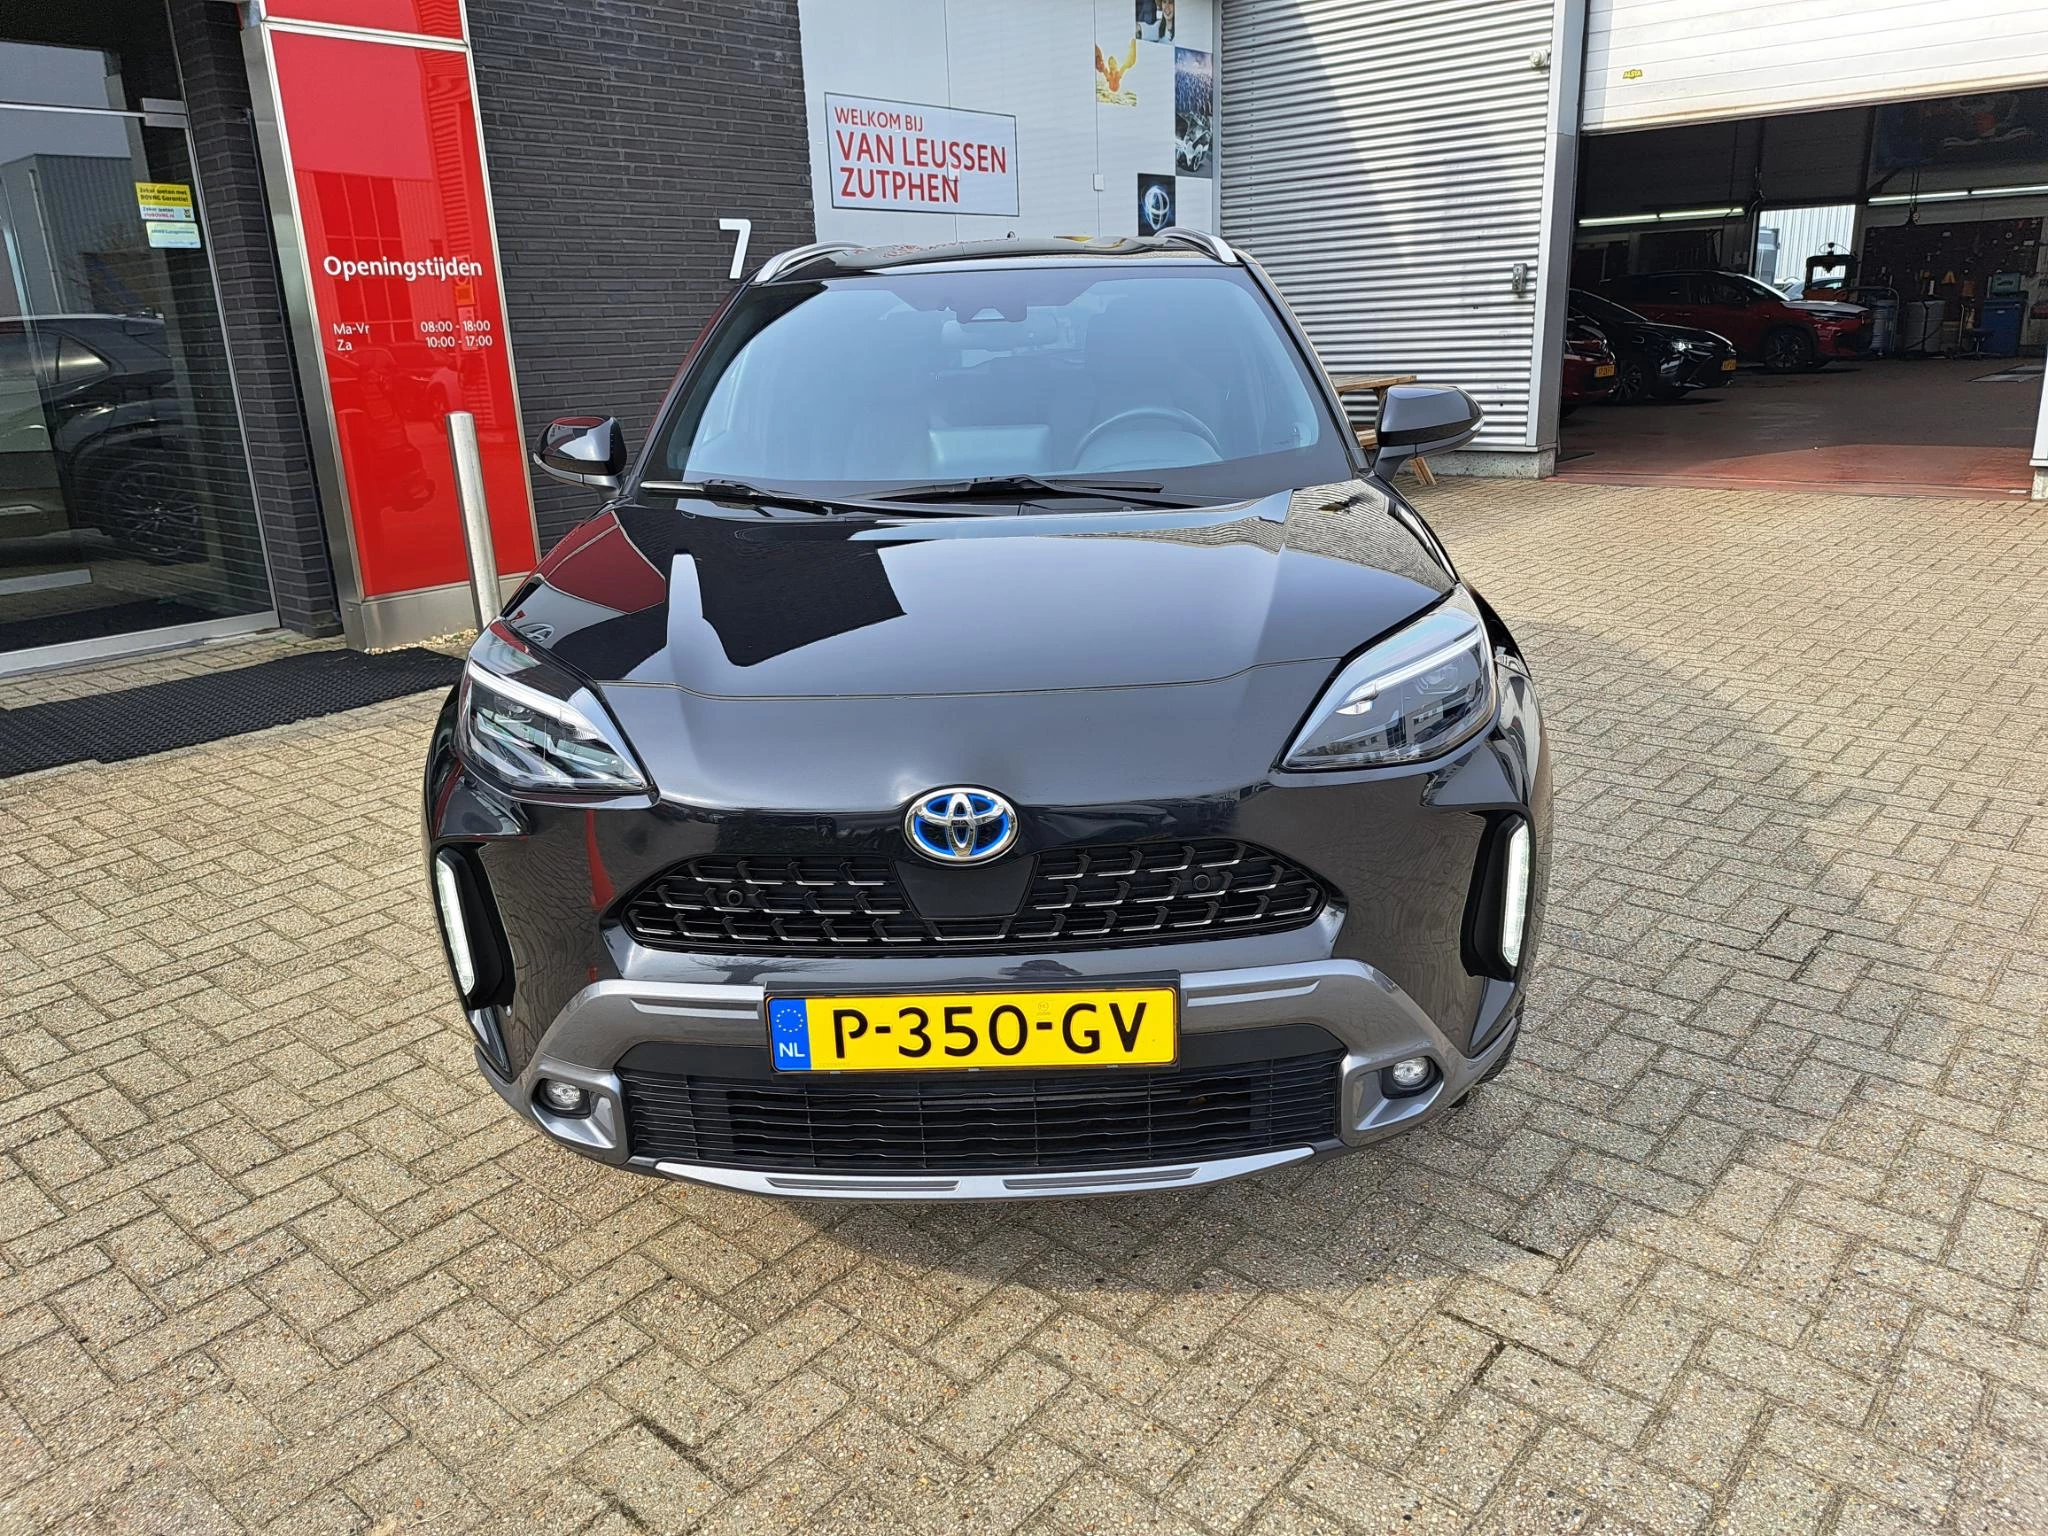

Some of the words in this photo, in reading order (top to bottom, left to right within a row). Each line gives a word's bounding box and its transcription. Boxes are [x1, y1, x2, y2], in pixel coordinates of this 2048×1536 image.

[834, 106, 901, 131] WELKOM
[905, 115, 923, 132] BIJ
[836, 130, 894, 165] VAN
[902, 136, 1007, 174] LEUSSEN
[840, 167, 959, 203] ZUTPHEN
[719, 218, 751, 279] 7
[323, 256, 483, 281] Openingstijden
[333, 322, 370, 335] Ma-Vr
[420, 320, 453, 332] 08:00
[463, 320, 491, 332] 18:00
[337, 339, 353, 351] Za
[426, 336, 455, 348] 10:00
[465, 335, 493, 347] 17:00
[832, 1001, 1148, 1060] P-350-GV
[778, 1042, 806, 1058] NL
